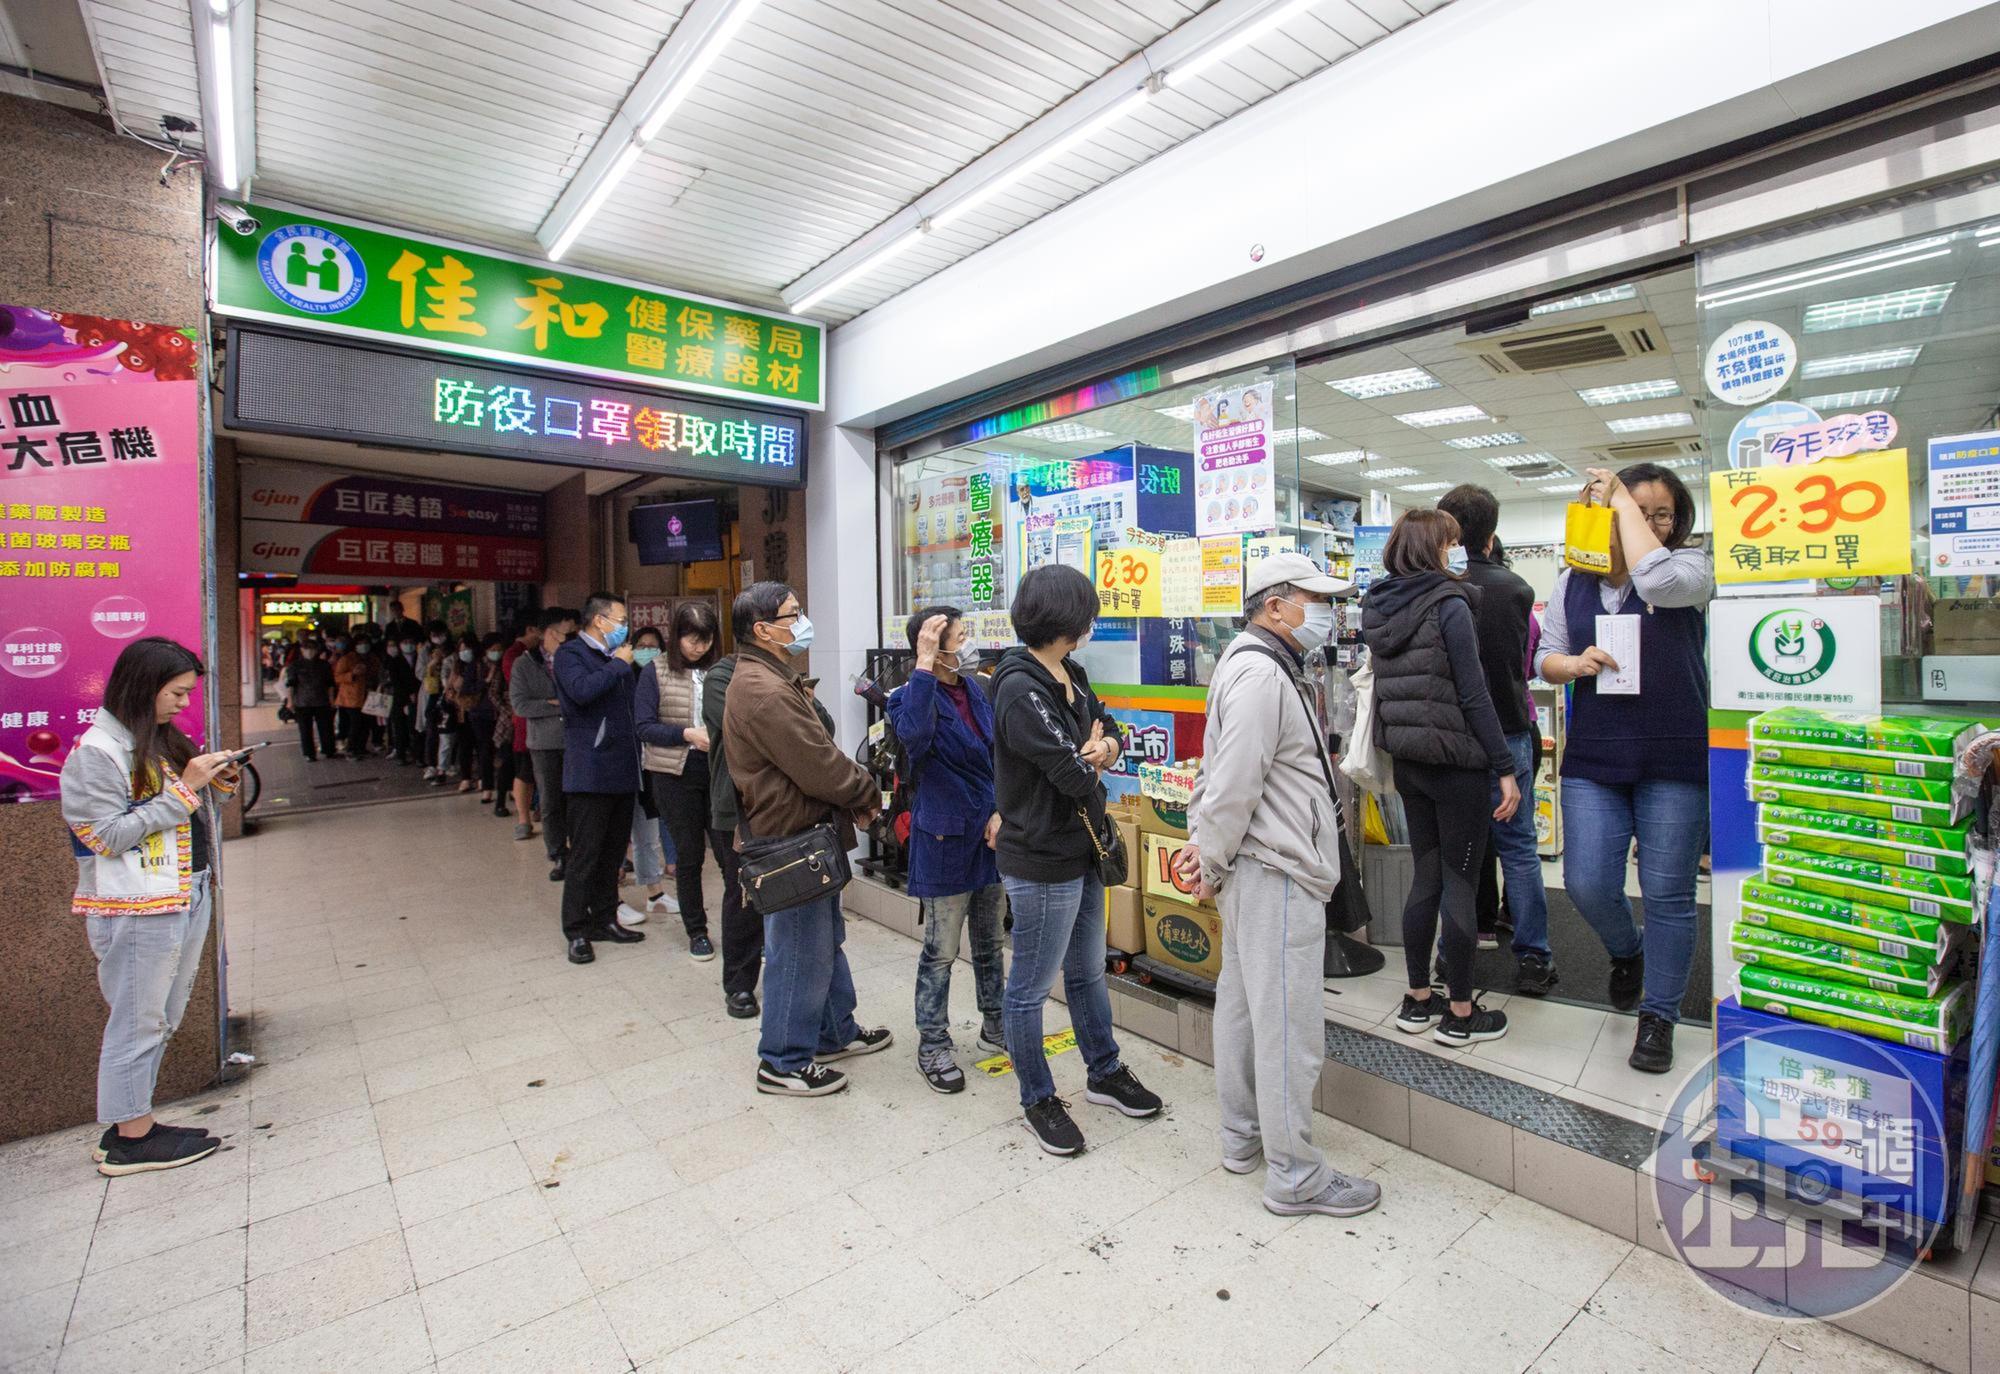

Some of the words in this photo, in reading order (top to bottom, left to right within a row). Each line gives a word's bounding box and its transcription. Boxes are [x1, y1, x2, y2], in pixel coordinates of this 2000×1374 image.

[262, 259, 289, 301] NATIONAL
[290, 298, 327, 312] HEALTH
[328, 277, 363, 311] INSURANCE
[387, 249, 608, 353] 佳和
[625, 295, 803, 359] 健保藥局
[625, 332, 803, 393] 醫療器材
[0, 393, 61, 429] 血
[434, 377, 795, 467] 防役口罩領取時間
[1, 426, 158, 470] 大危機
[251, 488, 301, 508] Gjun
[335, 488, 443, 520] 巨匠美語
[1730, 474, 1887, 540] 2:30
[252, 541, 301, 560] Gjun
[336, 538, 445, 567] 巨匠電腦
[968, 471, 994, 604] 醫療器
[1729, 534, 1860, 571] 領取口罩
[1101, 554, 1149, 589] 2:30
[93, 611, 146, 622] 美國專利
[1778, 1055, 1872, 1100] 倍潔雅
[1759, 1075, 1897, 1132] 抽取式衛生紙
